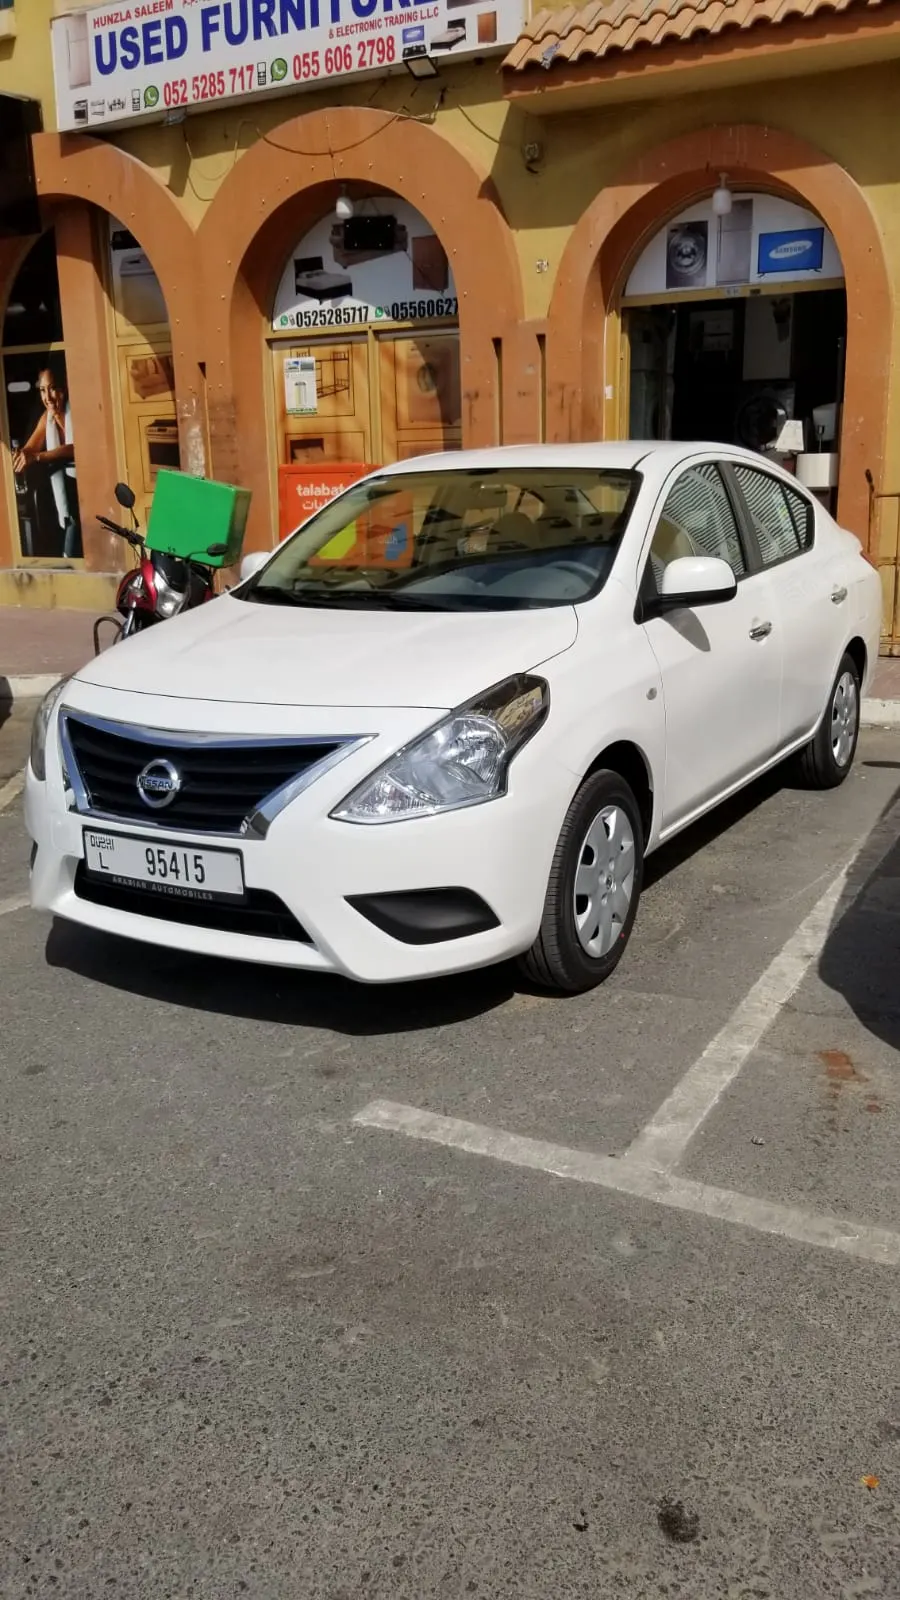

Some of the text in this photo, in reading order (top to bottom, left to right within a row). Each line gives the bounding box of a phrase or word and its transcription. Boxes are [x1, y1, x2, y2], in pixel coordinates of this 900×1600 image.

[93, 10, 132, 29] HUNZLA
[134, 0, 173, 18] SALEEM
[336, 18, 383, 38] ELECTRONIC
[384, 10, 418, 28] TRADING
[419, 6, 440, 20] L.L.C
[94, 0, 438, 75] USED FURNI
[292, 35, 396, 81] 055 606 2798
[163, 64, 255, 107] 052 5285 717
[296, 305, 369, 328] 0525285717
[138, 775, 174, 790] NISSAN
[98, 847, 206, 884] L 95415
[112, 876, 213, 900] ARABIAN AUTOMOBILES
